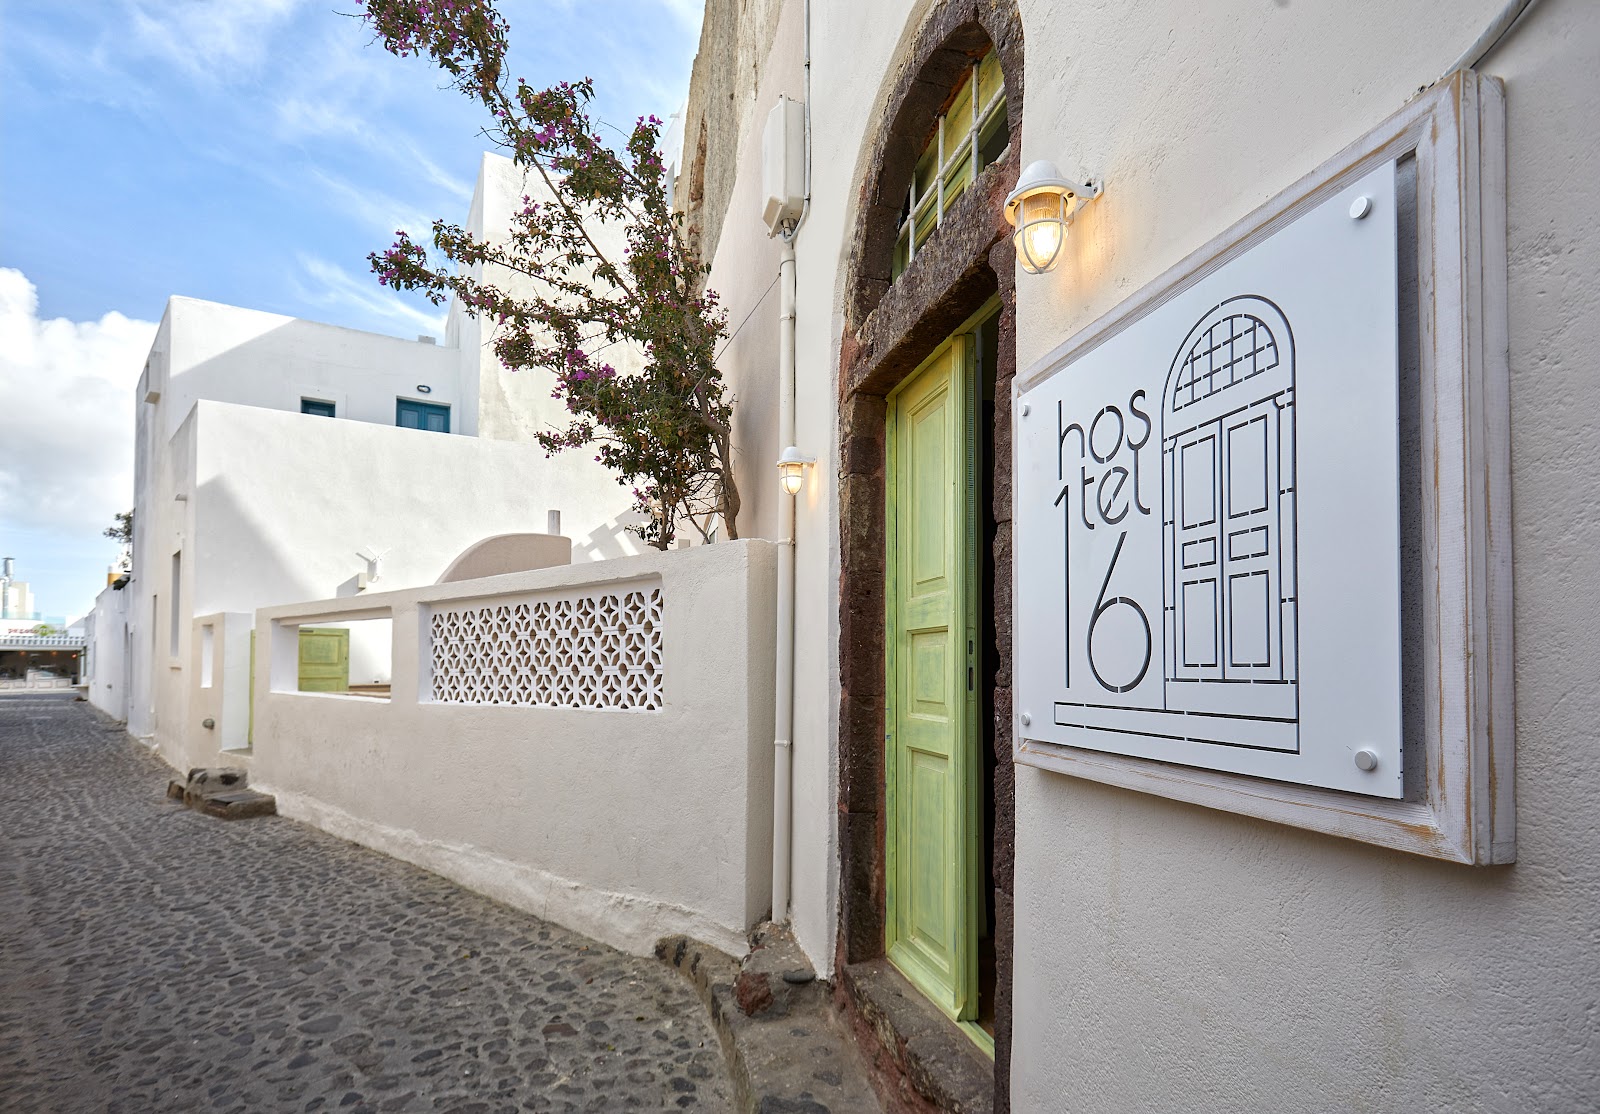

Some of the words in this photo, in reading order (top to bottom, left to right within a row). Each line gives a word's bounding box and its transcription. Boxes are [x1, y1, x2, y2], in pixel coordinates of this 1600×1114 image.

[1058, 389, 1151, 480] hos
[1081, 449, 1150, 530] tel
[1054, 484, 1152, 693] 16
